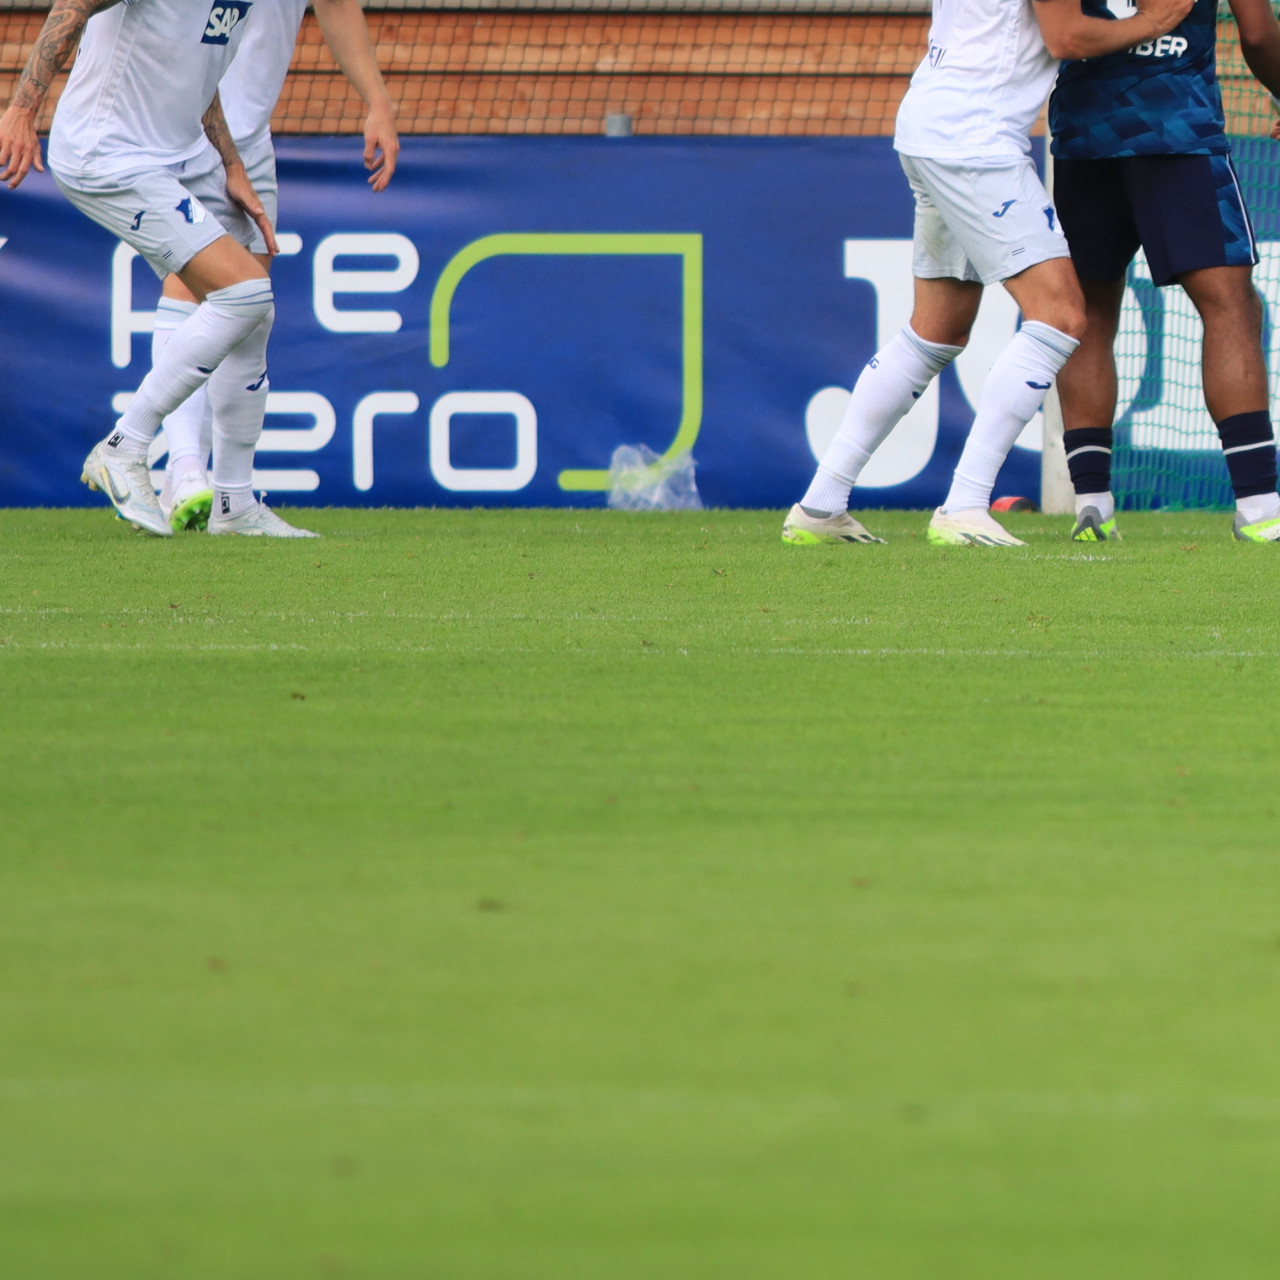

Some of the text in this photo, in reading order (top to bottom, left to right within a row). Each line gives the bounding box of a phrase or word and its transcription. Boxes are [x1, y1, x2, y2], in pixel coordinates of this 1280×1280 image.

[205, 7, 239, 37] SAP
[1128, 35, 1188, 59] BER
[112, 391, 538, 491] ero
